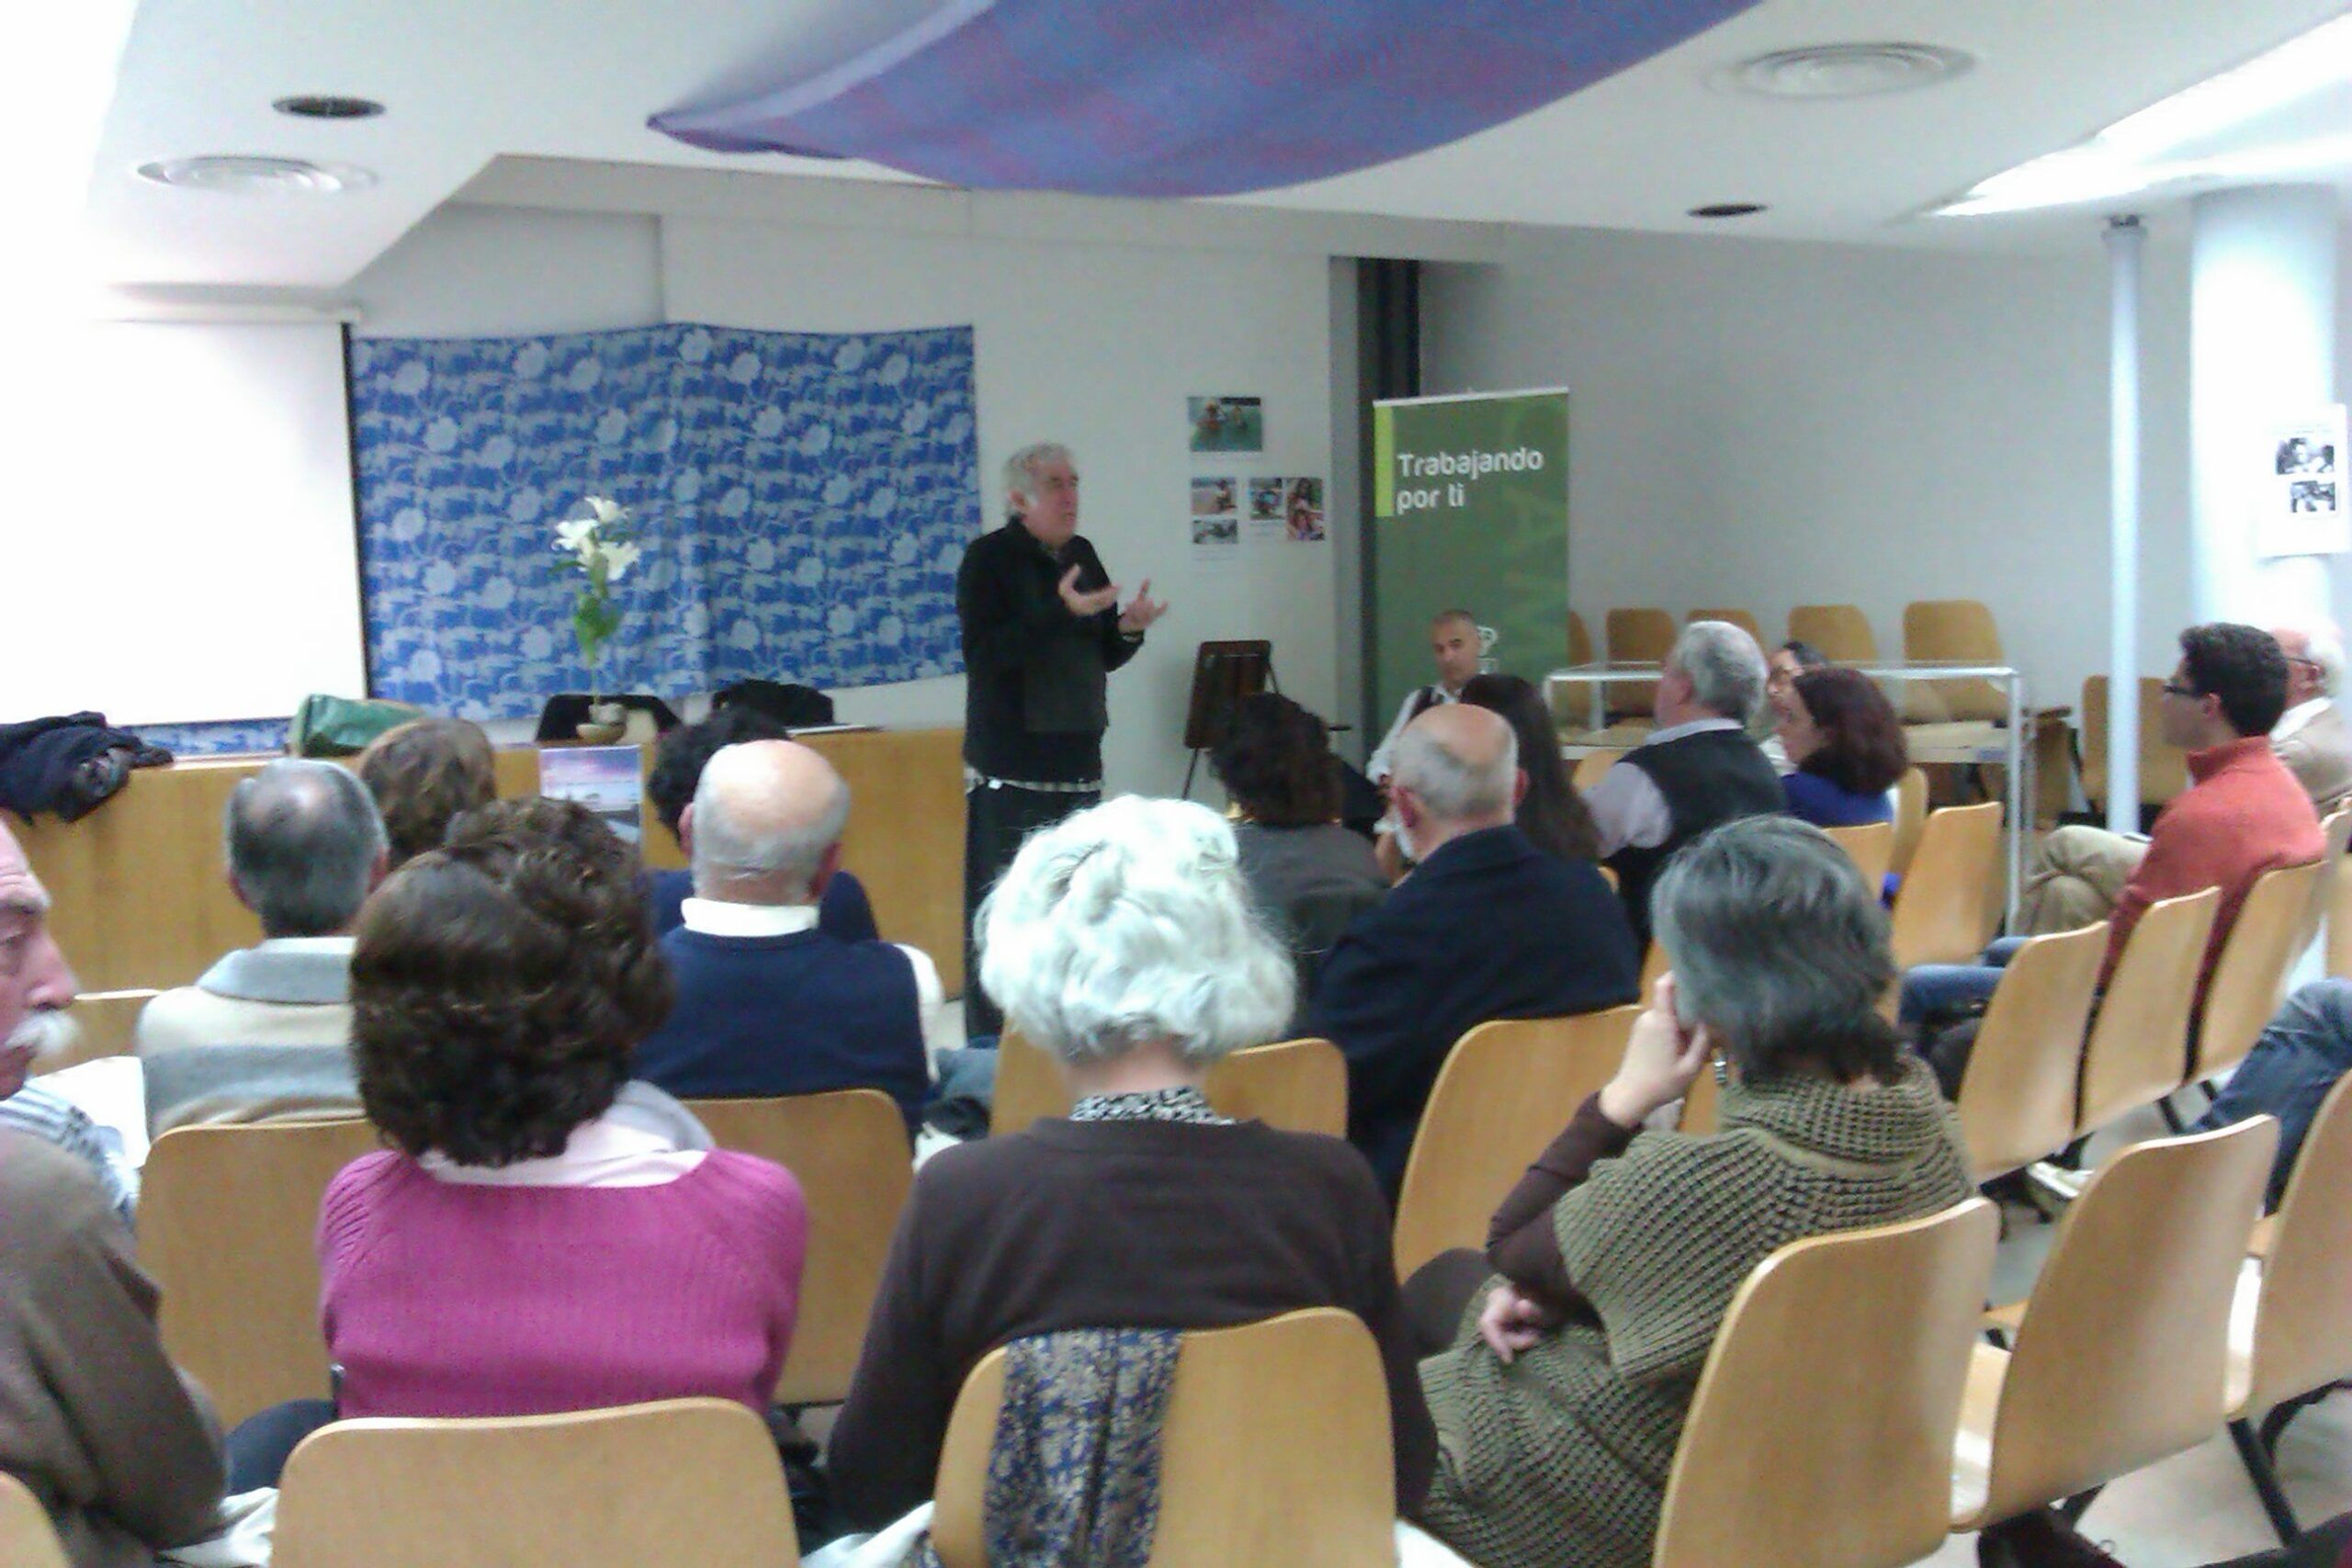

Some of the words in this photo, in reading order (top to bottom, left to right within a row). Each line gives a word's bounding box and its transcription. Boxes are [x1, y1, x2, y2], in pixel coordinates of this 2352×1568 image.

[1397, 447, 1544, 480] Trabajando
[1396, 489, 1439, 515] por
[1449, 482, 1464, 507] ti
